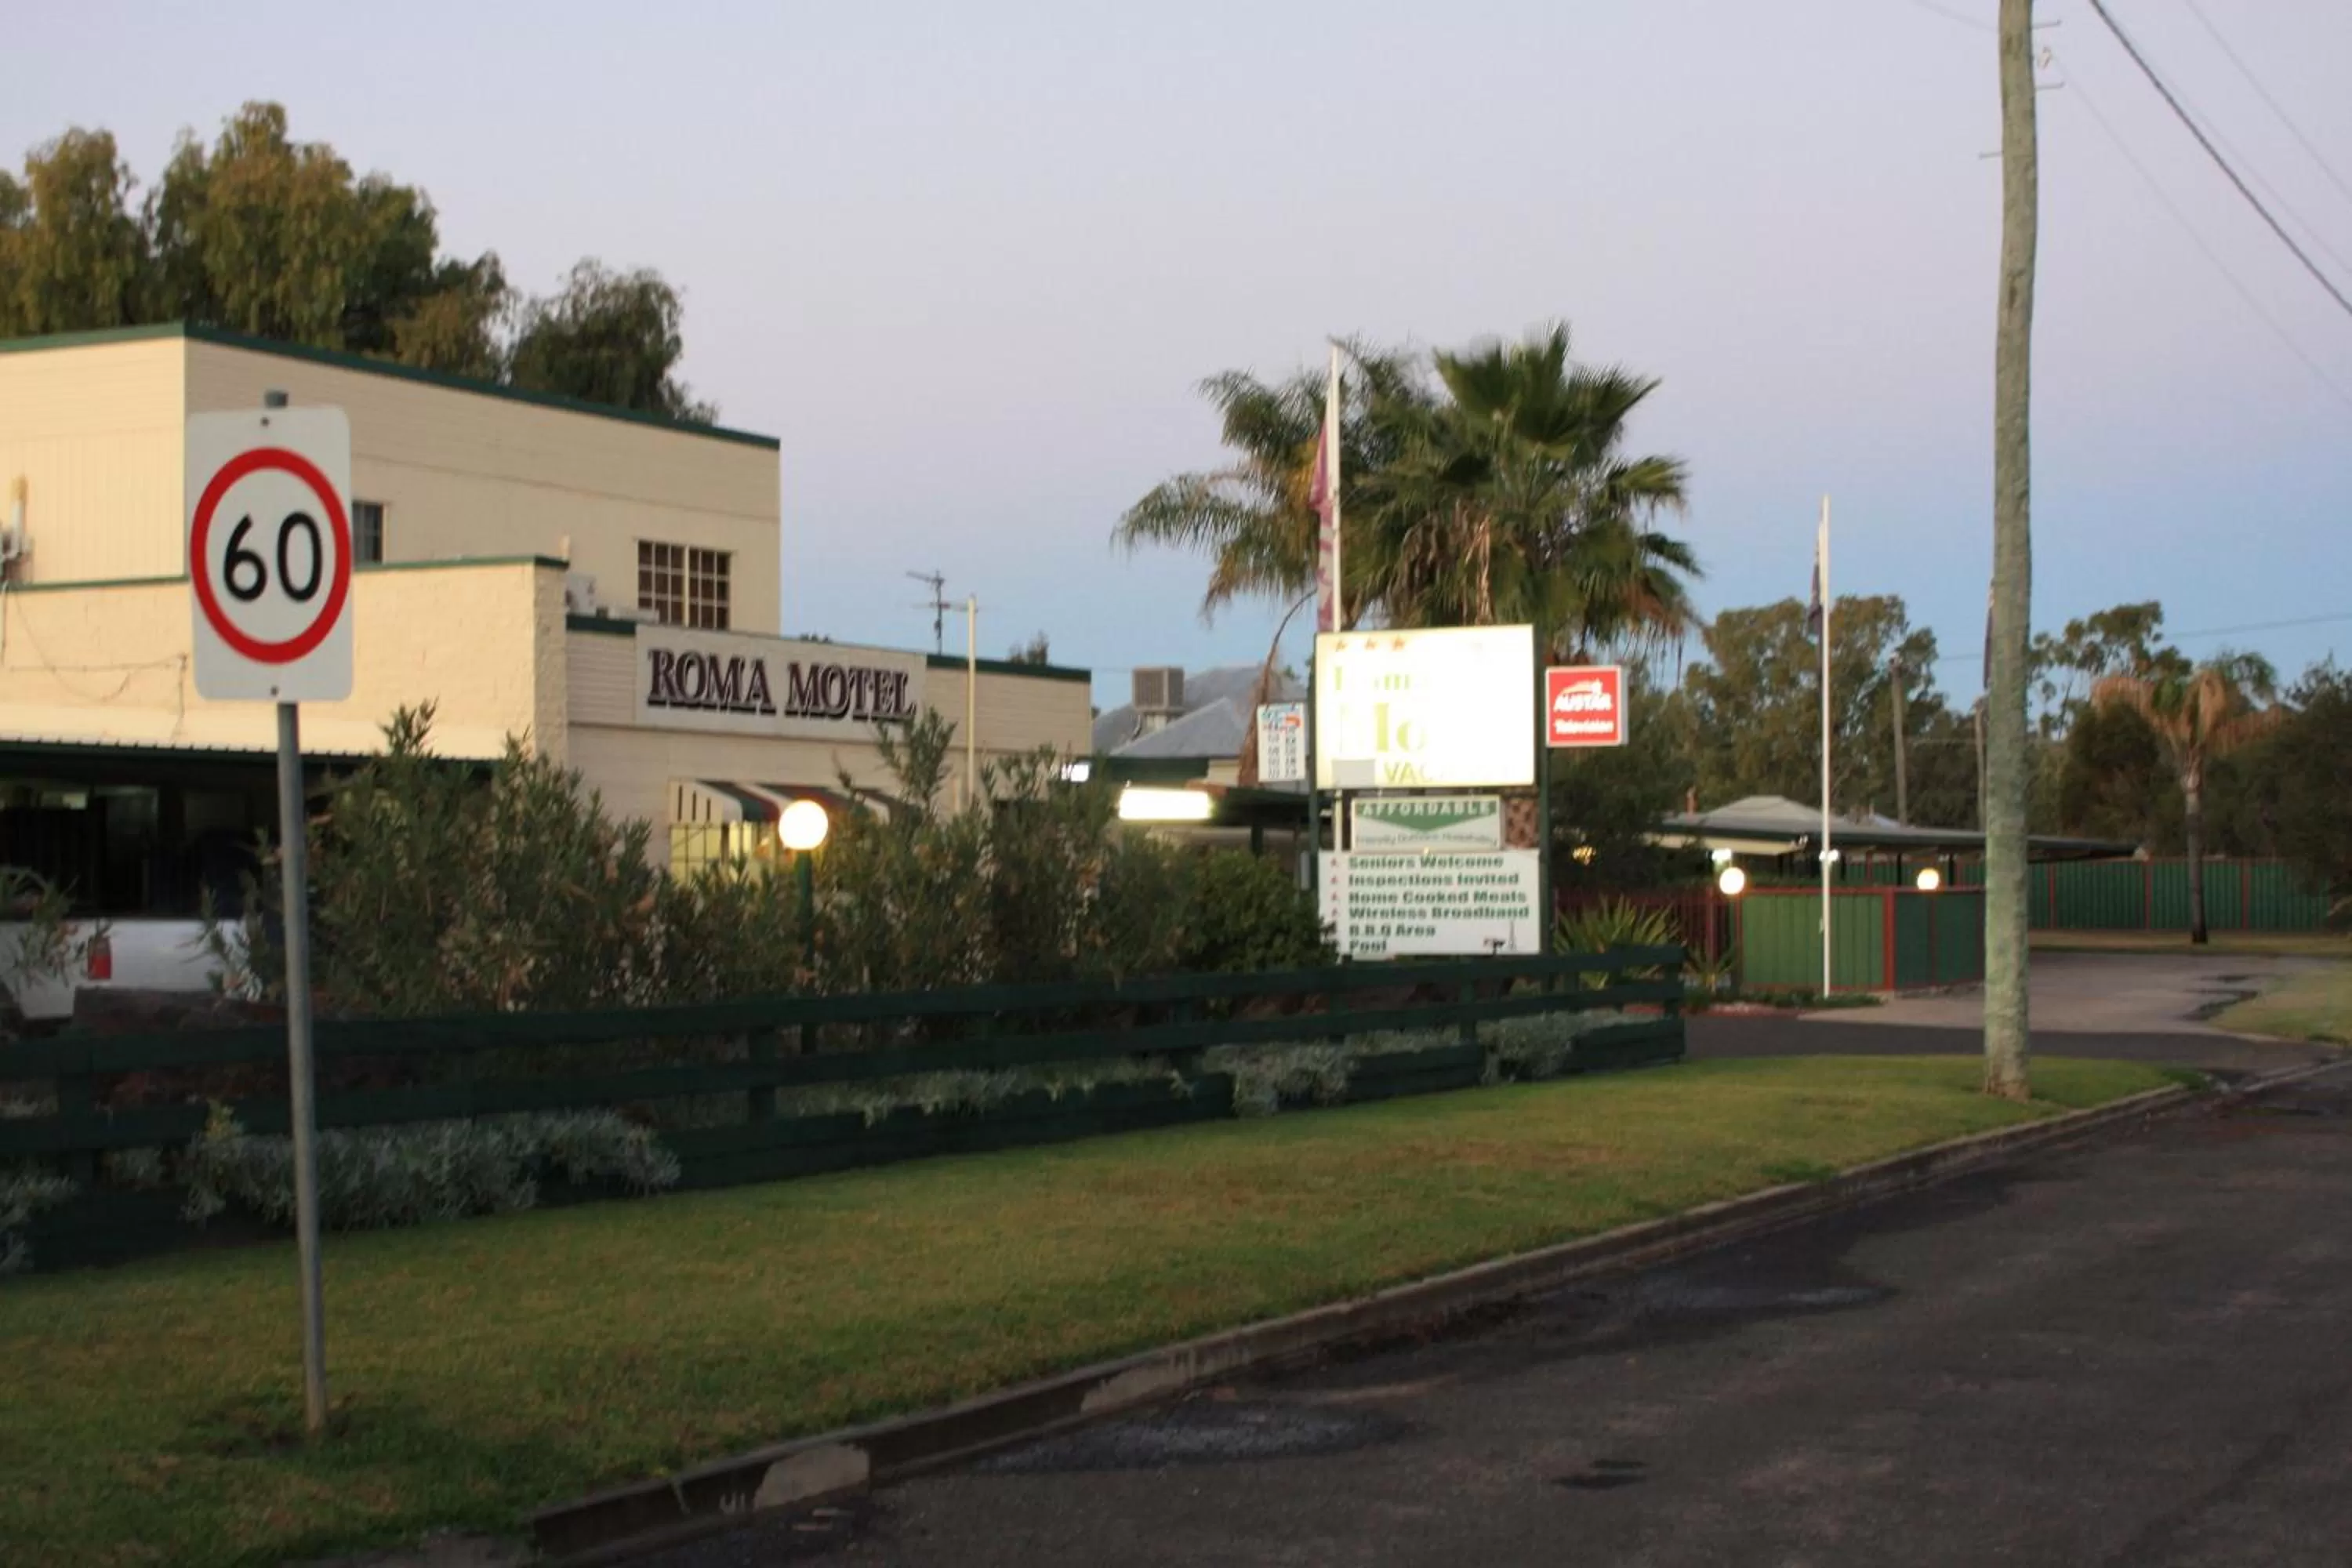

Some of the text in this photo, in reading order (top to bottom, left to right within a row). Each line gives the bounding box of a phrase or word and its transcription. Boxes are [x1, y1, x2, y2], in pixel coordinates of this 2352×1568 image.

[223, 510, 323, 603] 60
[648, 648, 916, 721] ROMA MOTEL
[1363, 800, 1491, 817] AFFORDABLE
[1348, 855, 1504, 869] Seniors Welcome
[1348, 873, 1519, 887] Inspections Invited
[1348, 891, 1526, 905] Home Cooked Meals
[1348, 906, 1529, 920] Wireless Broadband
[1396, 924, 1436, 937] Area
[1348, 940, 1388, 953] Pool
